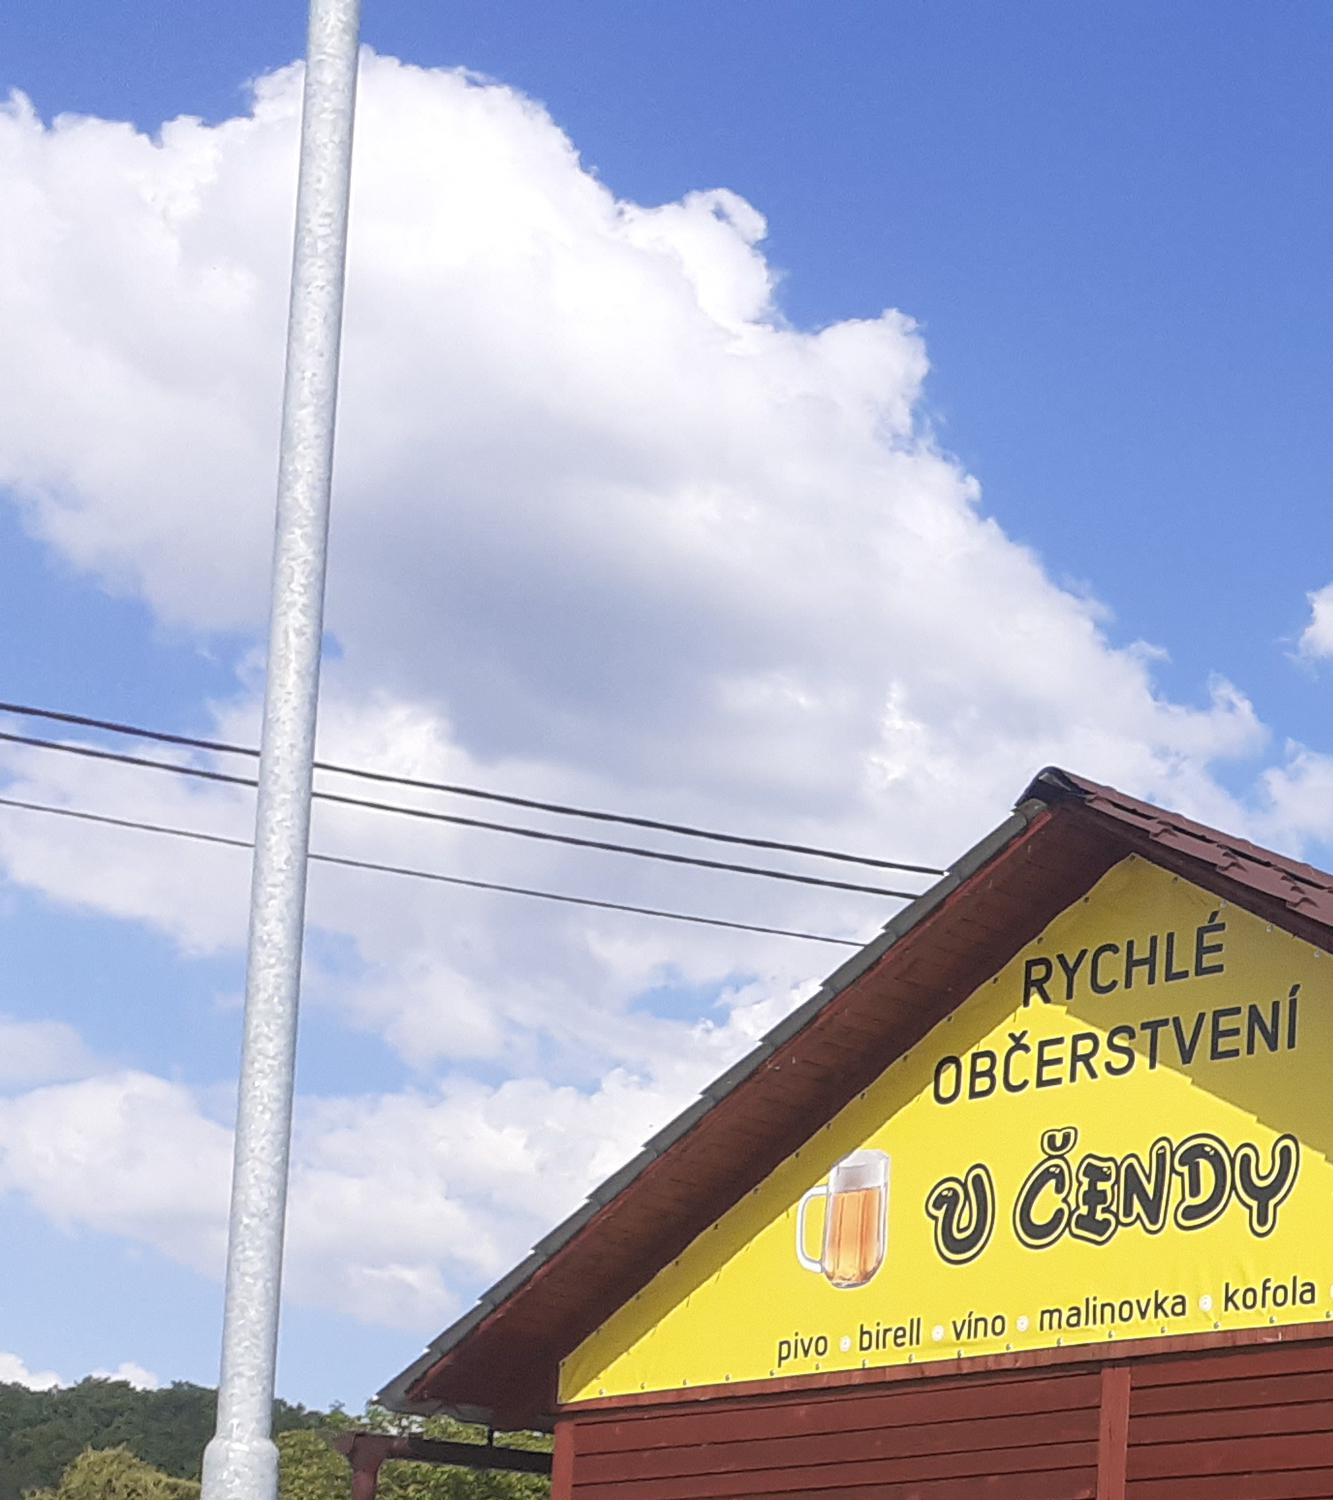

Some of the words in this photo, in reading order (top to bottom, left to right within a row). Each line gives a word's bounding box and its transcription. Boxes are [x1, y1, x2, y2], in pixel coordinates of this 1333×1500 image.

[1023, 911, 1226, 1006] RYCHLÉ
[933, 984, 1300, 1105] OBČERSTVENÍ
[927, 1163, 995, 1264] U
[1013, 1126, 1301, 1246] ČENDY
[777, 1328, 829, 1367] pivo
[858, 1318, 922, 1352] birell
[951, 1310, 1007, 1343] víno
[1039, 1289, 1187, 1333] malinovka
[1223, 1279, 1317, 1313] kofola
